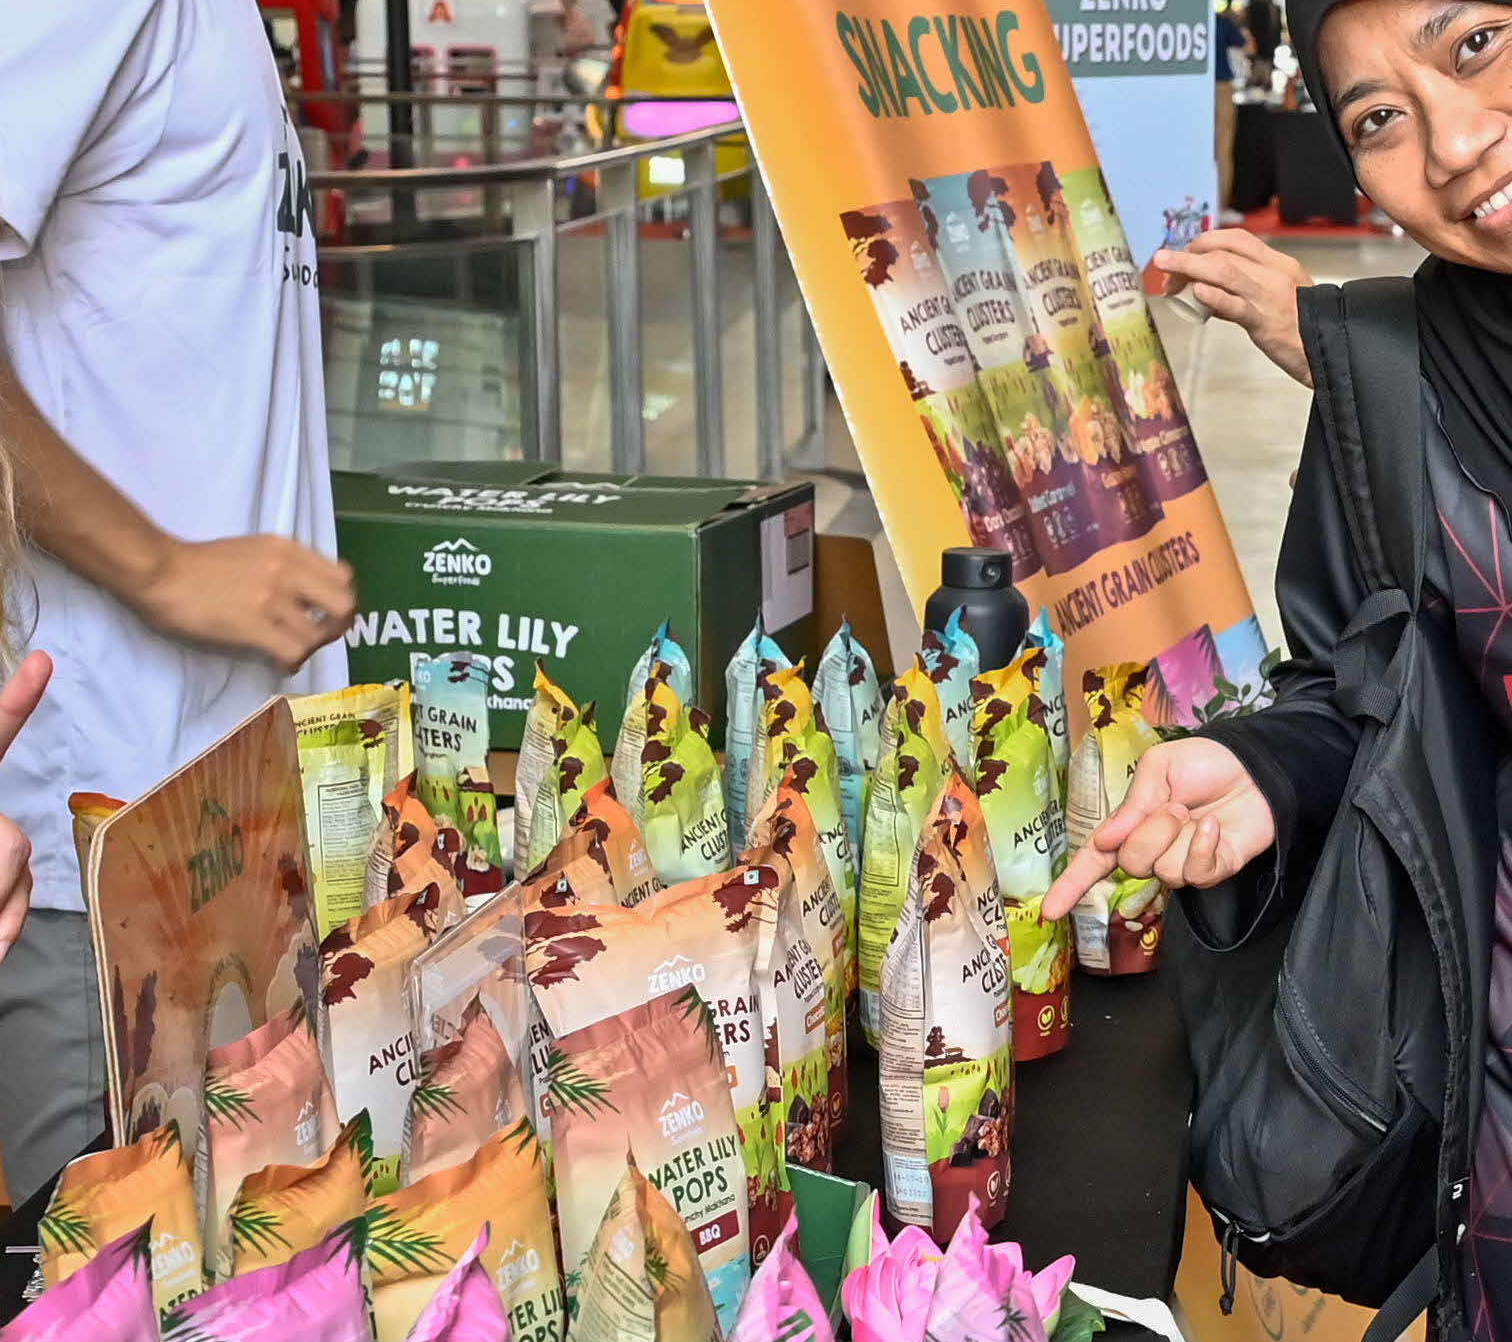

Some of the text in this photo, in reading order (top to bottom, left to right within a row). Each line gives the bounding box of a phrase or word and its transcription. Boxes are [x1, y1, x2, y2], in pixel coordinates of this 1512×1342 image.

[1054, 23, 1209, 65] UPERFOODS
[836, 10, 1046, 120] SNACKING
[966, 299, 1016, 333] CLUSTERS
[423, 549, 492, 577] ZENKO
[1054, 529, 1202, 638] ANCIENT GRAIN CLUSTERS
[344, 607, 580, 659] WATER LILY
[427, 707, 477, 734] GRAIN
[680, 811, 719, 855] ANCIENT
[648, 963, 706, 995] ZENKO
[367, 1032, 413, 1076] ANCI
[658, 1101, 705, 1138] ZENKO
[707, 1134, 739, 1168] LILY
[672, 1165, 730, 1212] POPS
[698, 1223, 723, 1247] BBQ
